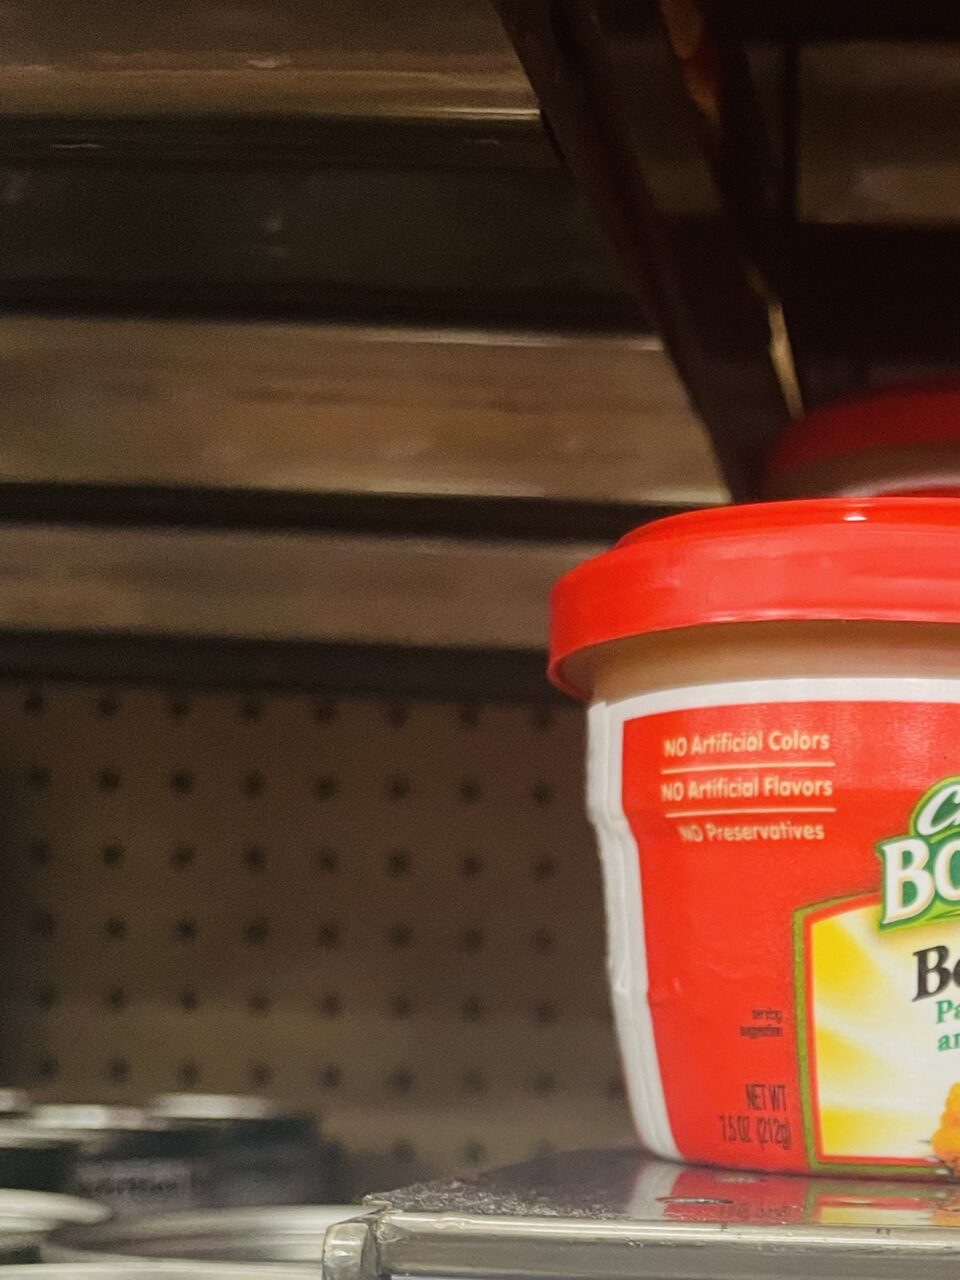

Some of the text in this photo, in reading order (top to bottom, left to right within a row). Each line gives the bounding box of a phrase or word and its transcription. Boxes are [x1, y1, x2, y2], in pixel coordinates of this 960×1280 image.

[663, 729, 830, 757] NO Artificial Colors
[660, 775, 833, 801] NO Artificial Flavors
[677, 821, 825, 842] NO Preservatives
[745, 1084, 788, 1112] NET WT
